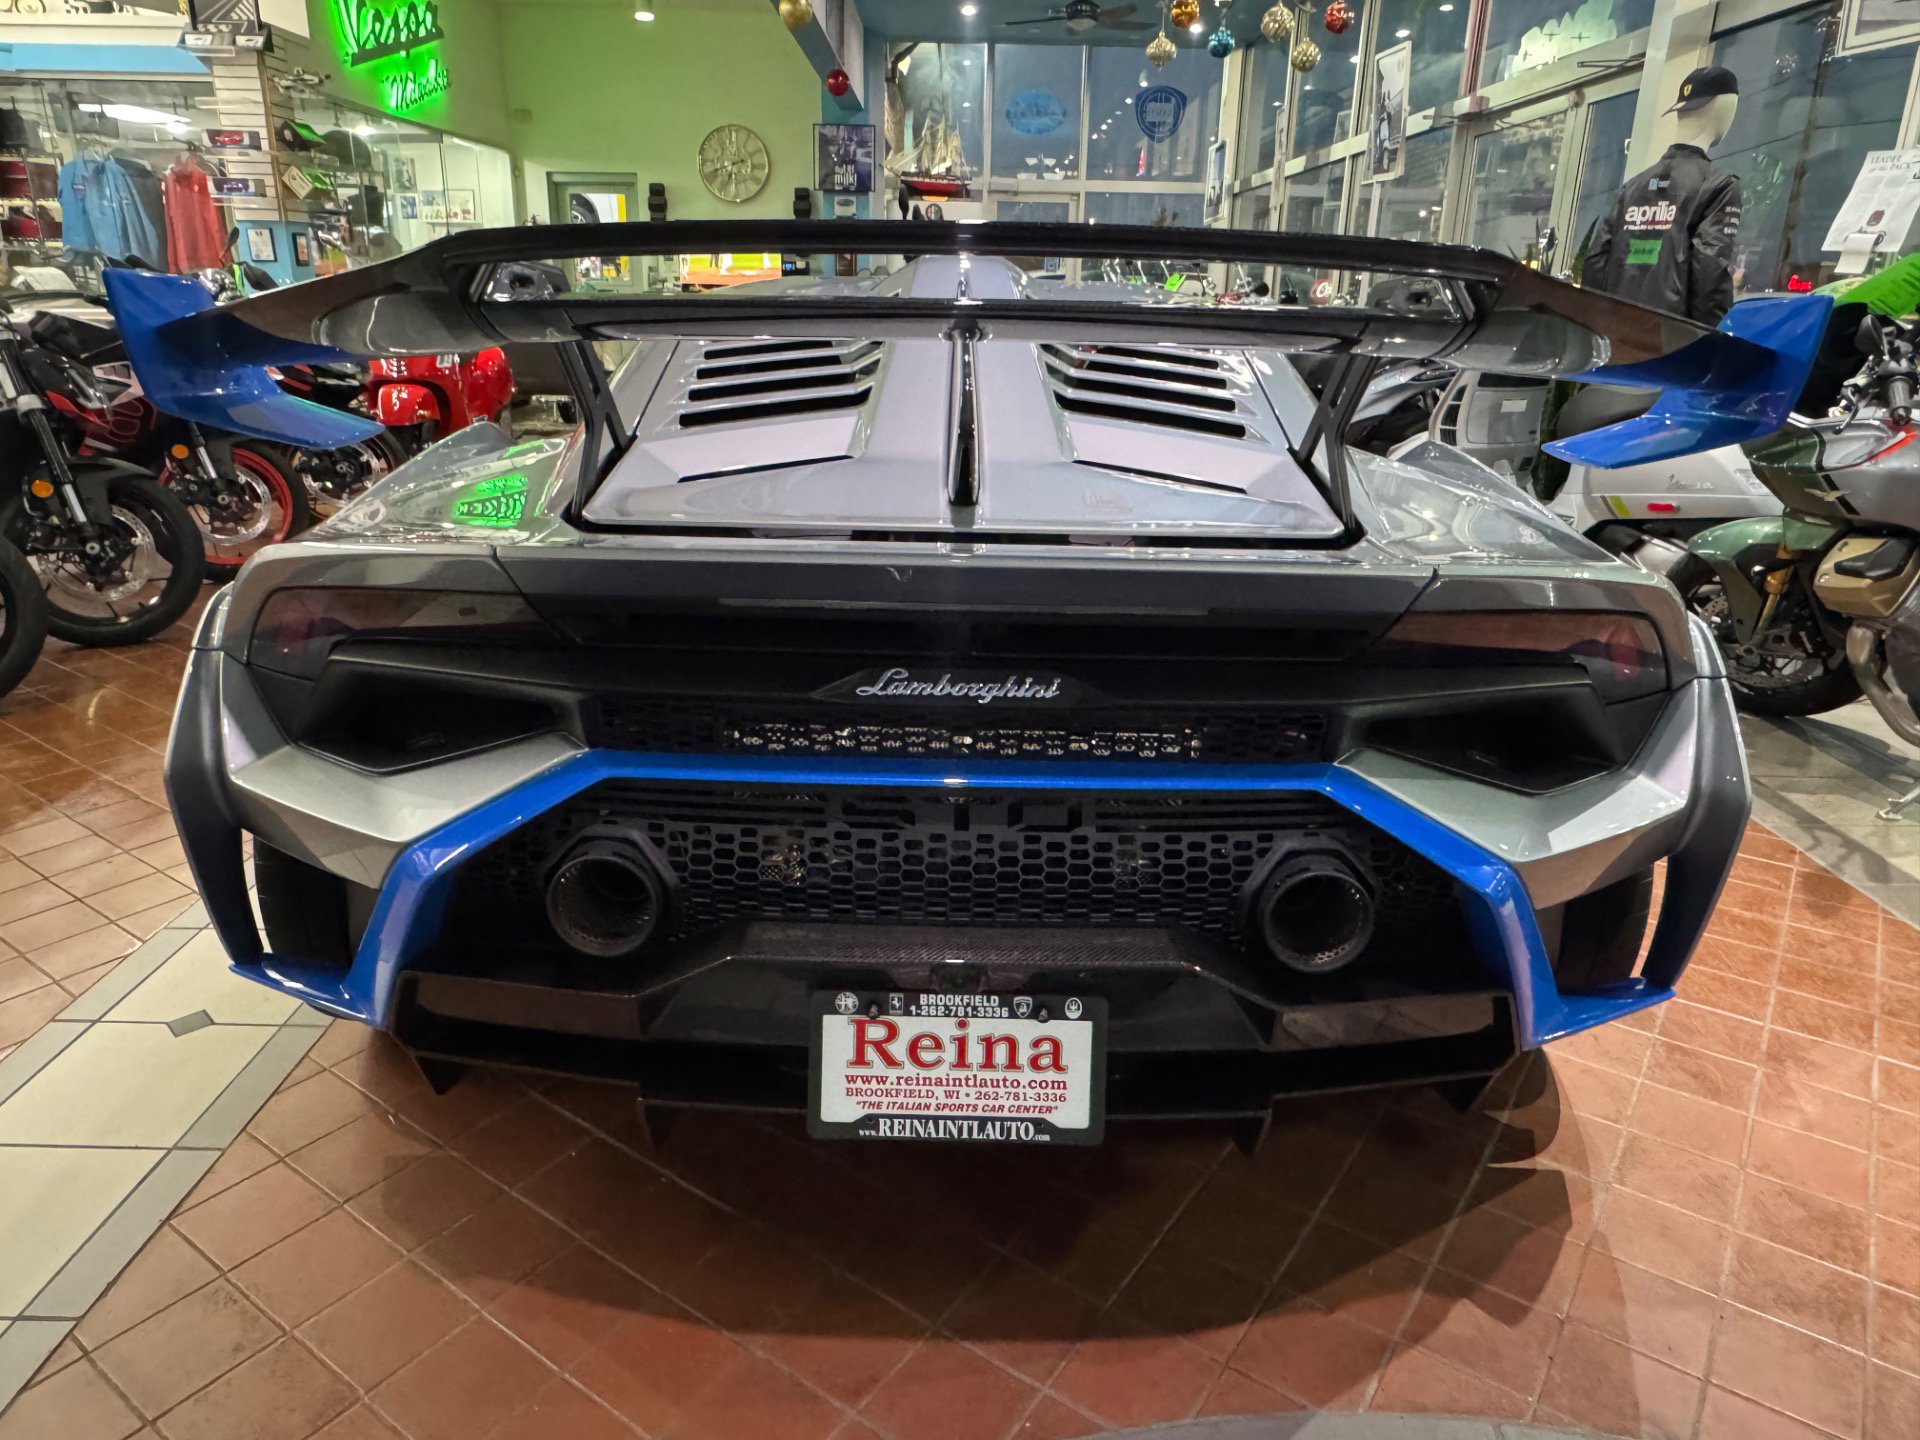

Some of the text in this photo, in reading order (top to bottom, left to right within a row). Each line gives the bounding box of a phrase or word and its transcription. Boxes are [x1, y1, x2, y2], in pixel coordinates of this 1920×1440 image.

[1624, 201, 1677, 225] aprilia
[856, 667, 1060, 704] Lamborghini
[919, 993, 999, 1007] BROOKFIELD
[909, 1005, 1009, 1018] 1-262-781-3336
[847, 1017, 1068, 1074] Reina
[844, 1073, 1068, 1091] www.reinaintlauto.com
[845, 1087, 1067, 1103] BROOKFIELD, WI 262-781-3336
[856, 1100, 1058, 1115] "THE ITALIAN SPORTS CAR CENTER"
